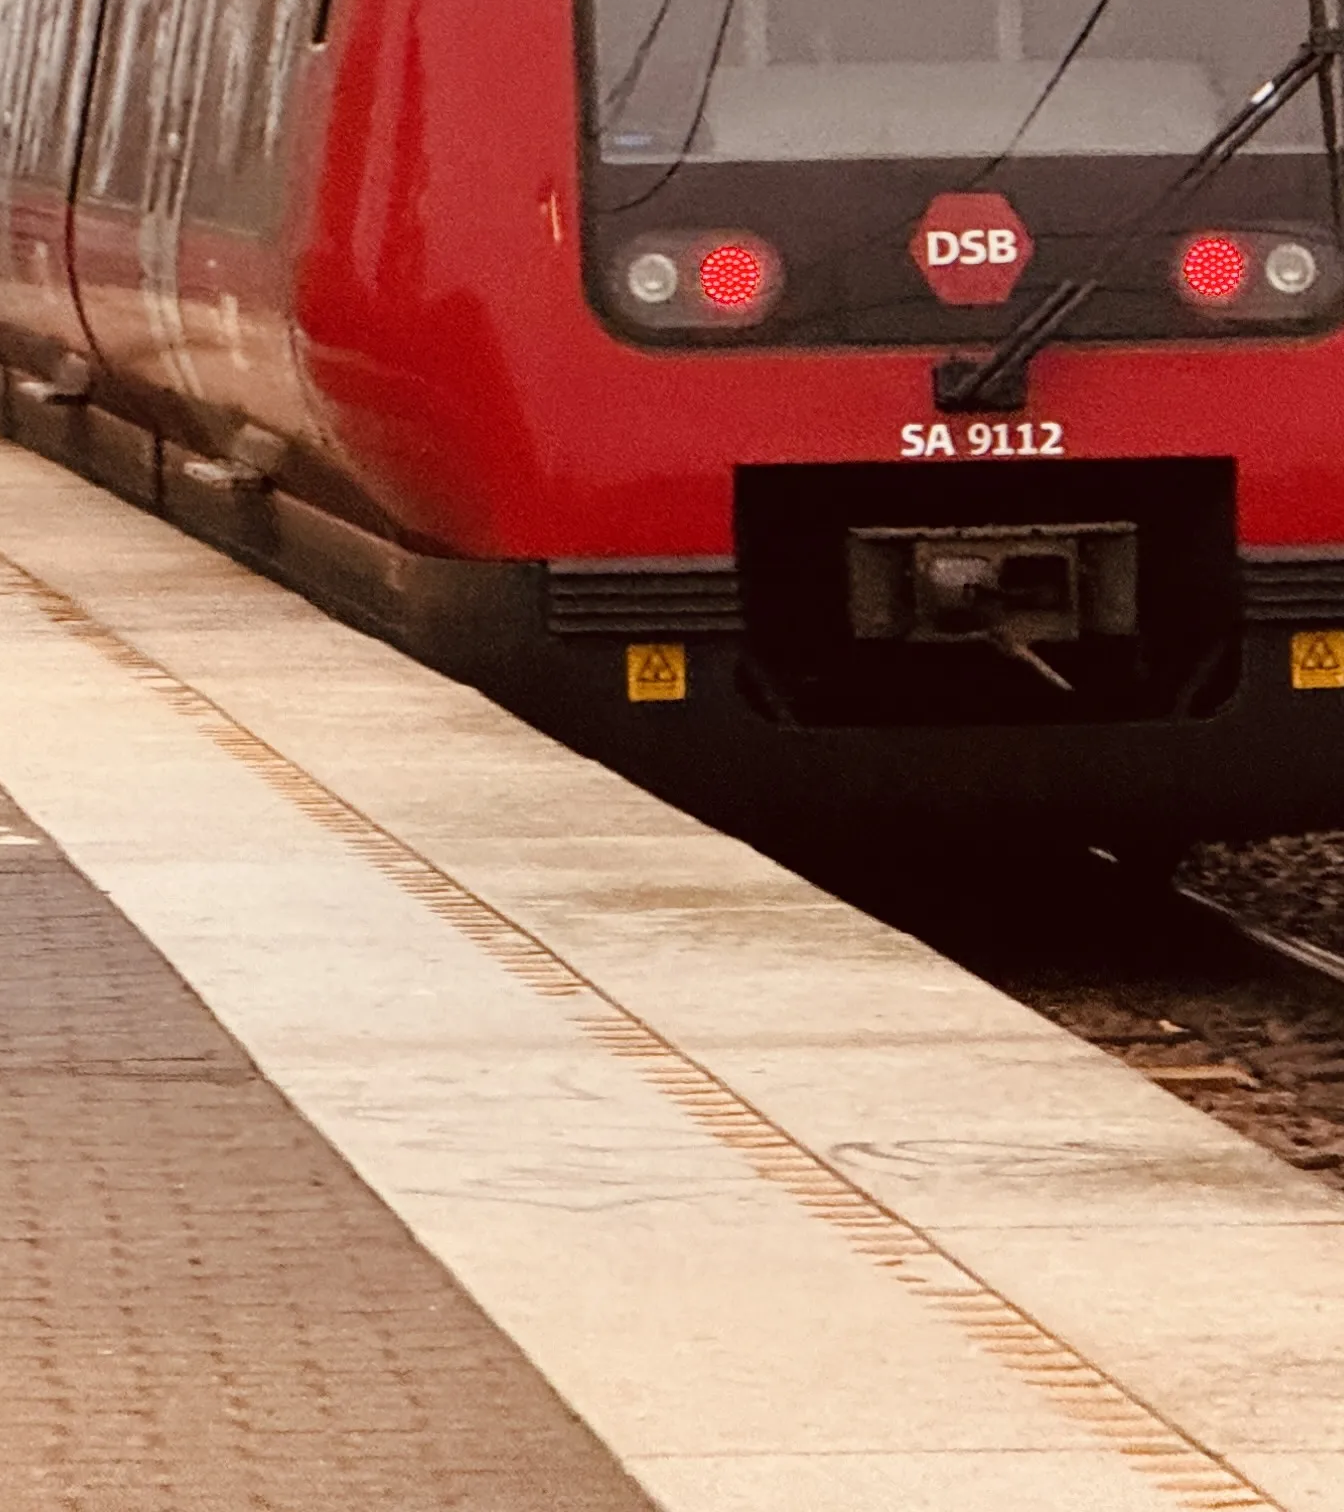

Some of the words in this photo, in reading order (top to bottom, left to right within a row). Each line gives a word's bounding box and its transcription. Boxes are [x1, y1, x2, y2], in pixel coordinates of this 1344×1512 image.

[926, 228, 1018, 267] DSB
[900, 423, 956, 457] SA
[967, 421, 1065, 457] 9112
